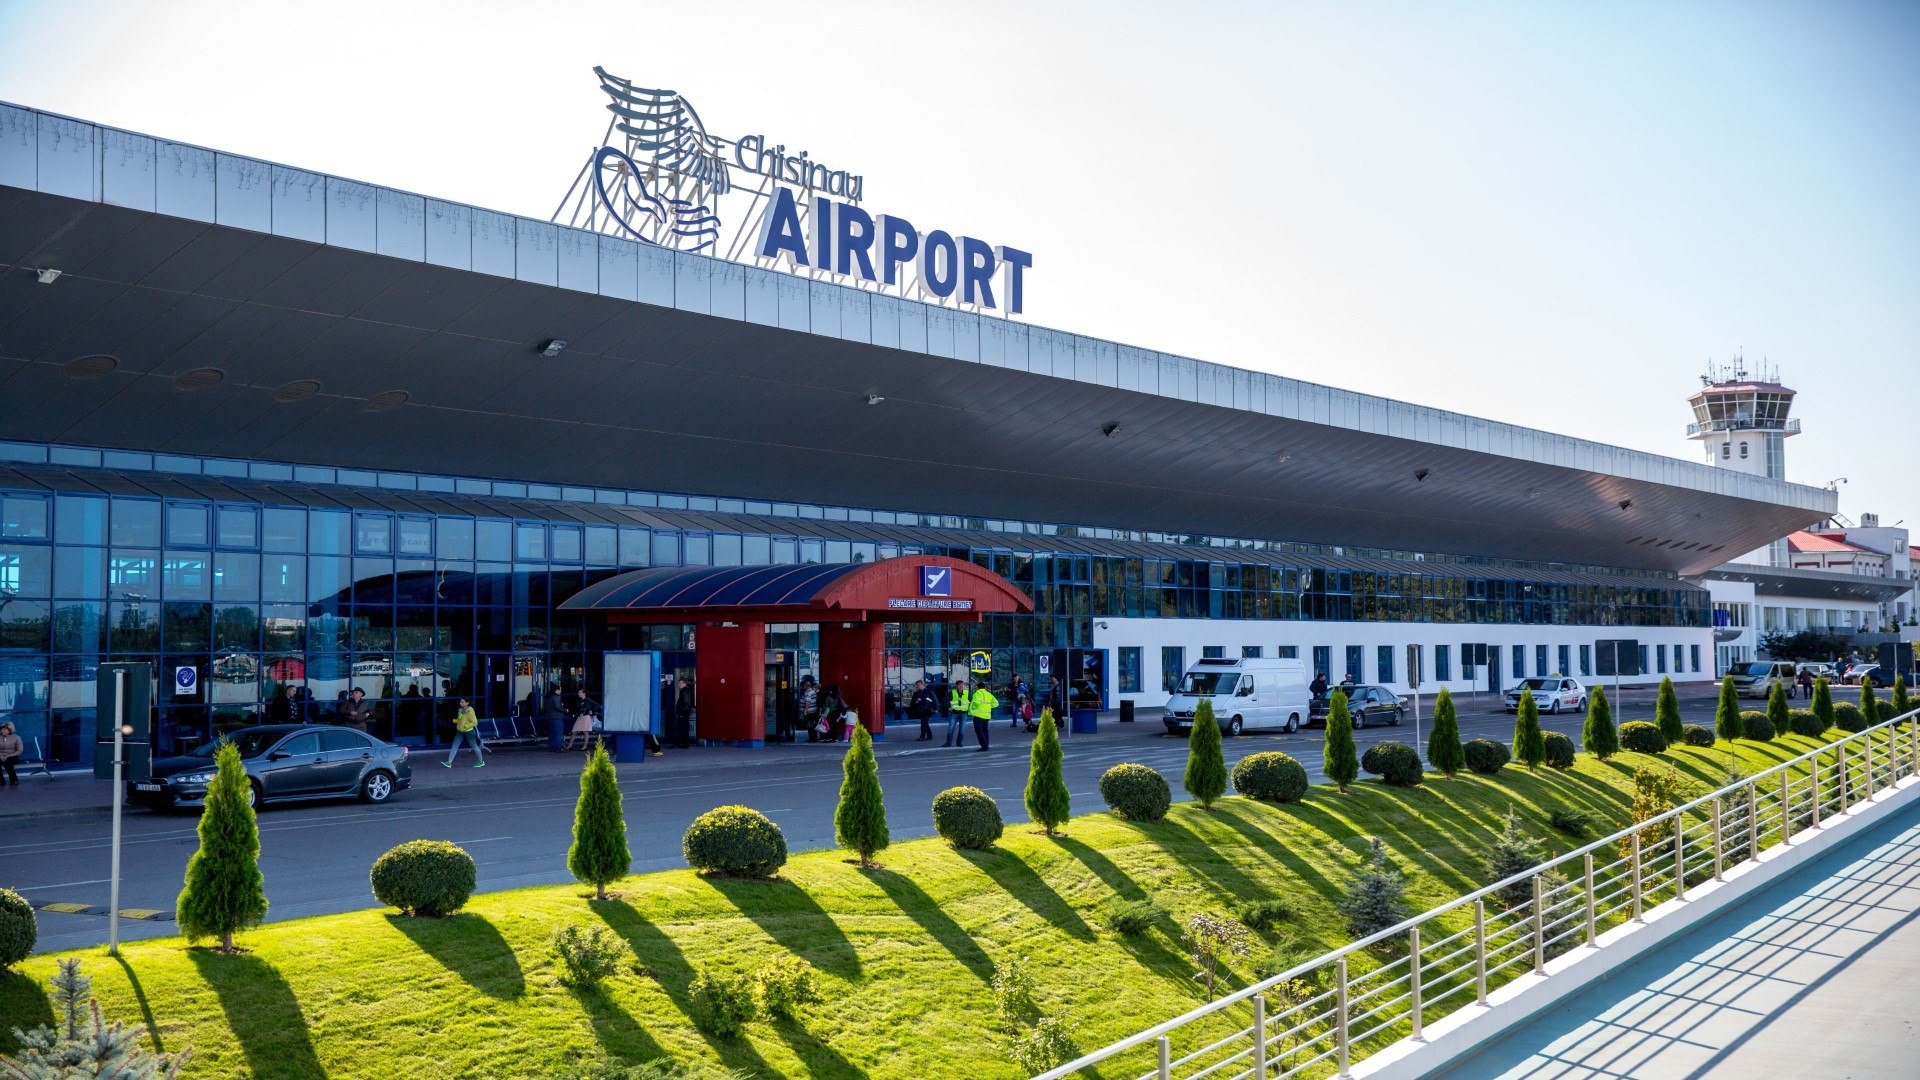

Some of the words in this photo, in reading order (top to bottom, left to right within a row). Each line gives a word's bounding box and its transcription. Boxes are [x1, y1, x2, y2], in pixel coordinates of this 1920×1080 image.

[735, 134, 863, 201] Chisinau
[756, 186, 1033, 314] AIRPORT
[888, 599, 916, 608] PLECARE
[917, 600, 952, 609] DEPARTURE
[1713, 609, 1730, 627] VIP
